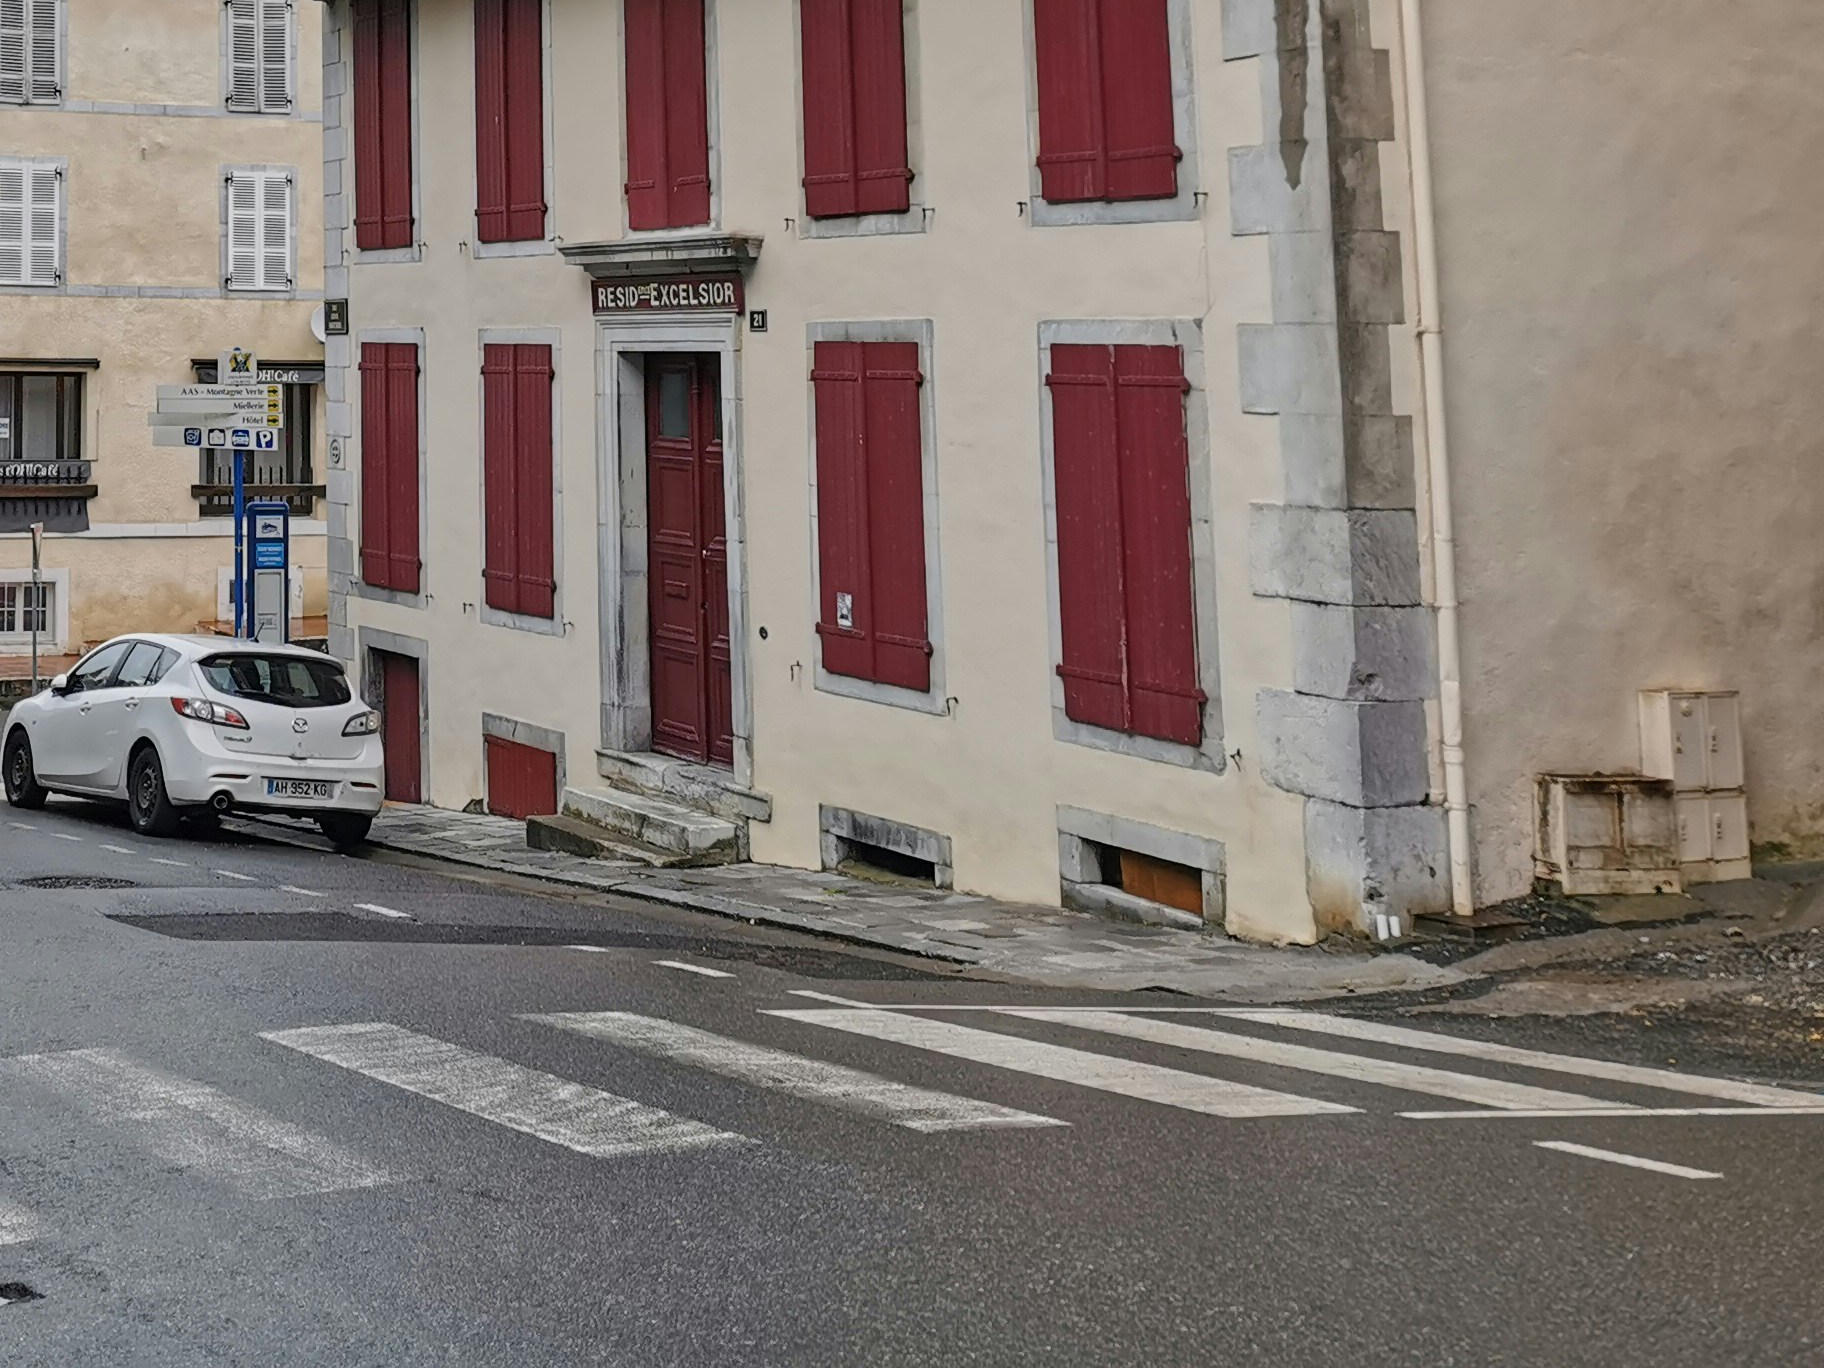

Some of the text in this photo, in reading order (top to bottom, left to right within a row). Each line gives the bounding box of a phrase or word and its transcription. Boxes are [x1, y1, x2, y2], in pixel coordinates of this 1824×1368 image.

[650, 282, 735, 306] EXCELSIOR
[752, 313, 763, 327] 21
[206, 388, 243, 397] Montagne
[242, 416, 264, 424] Hôtel
